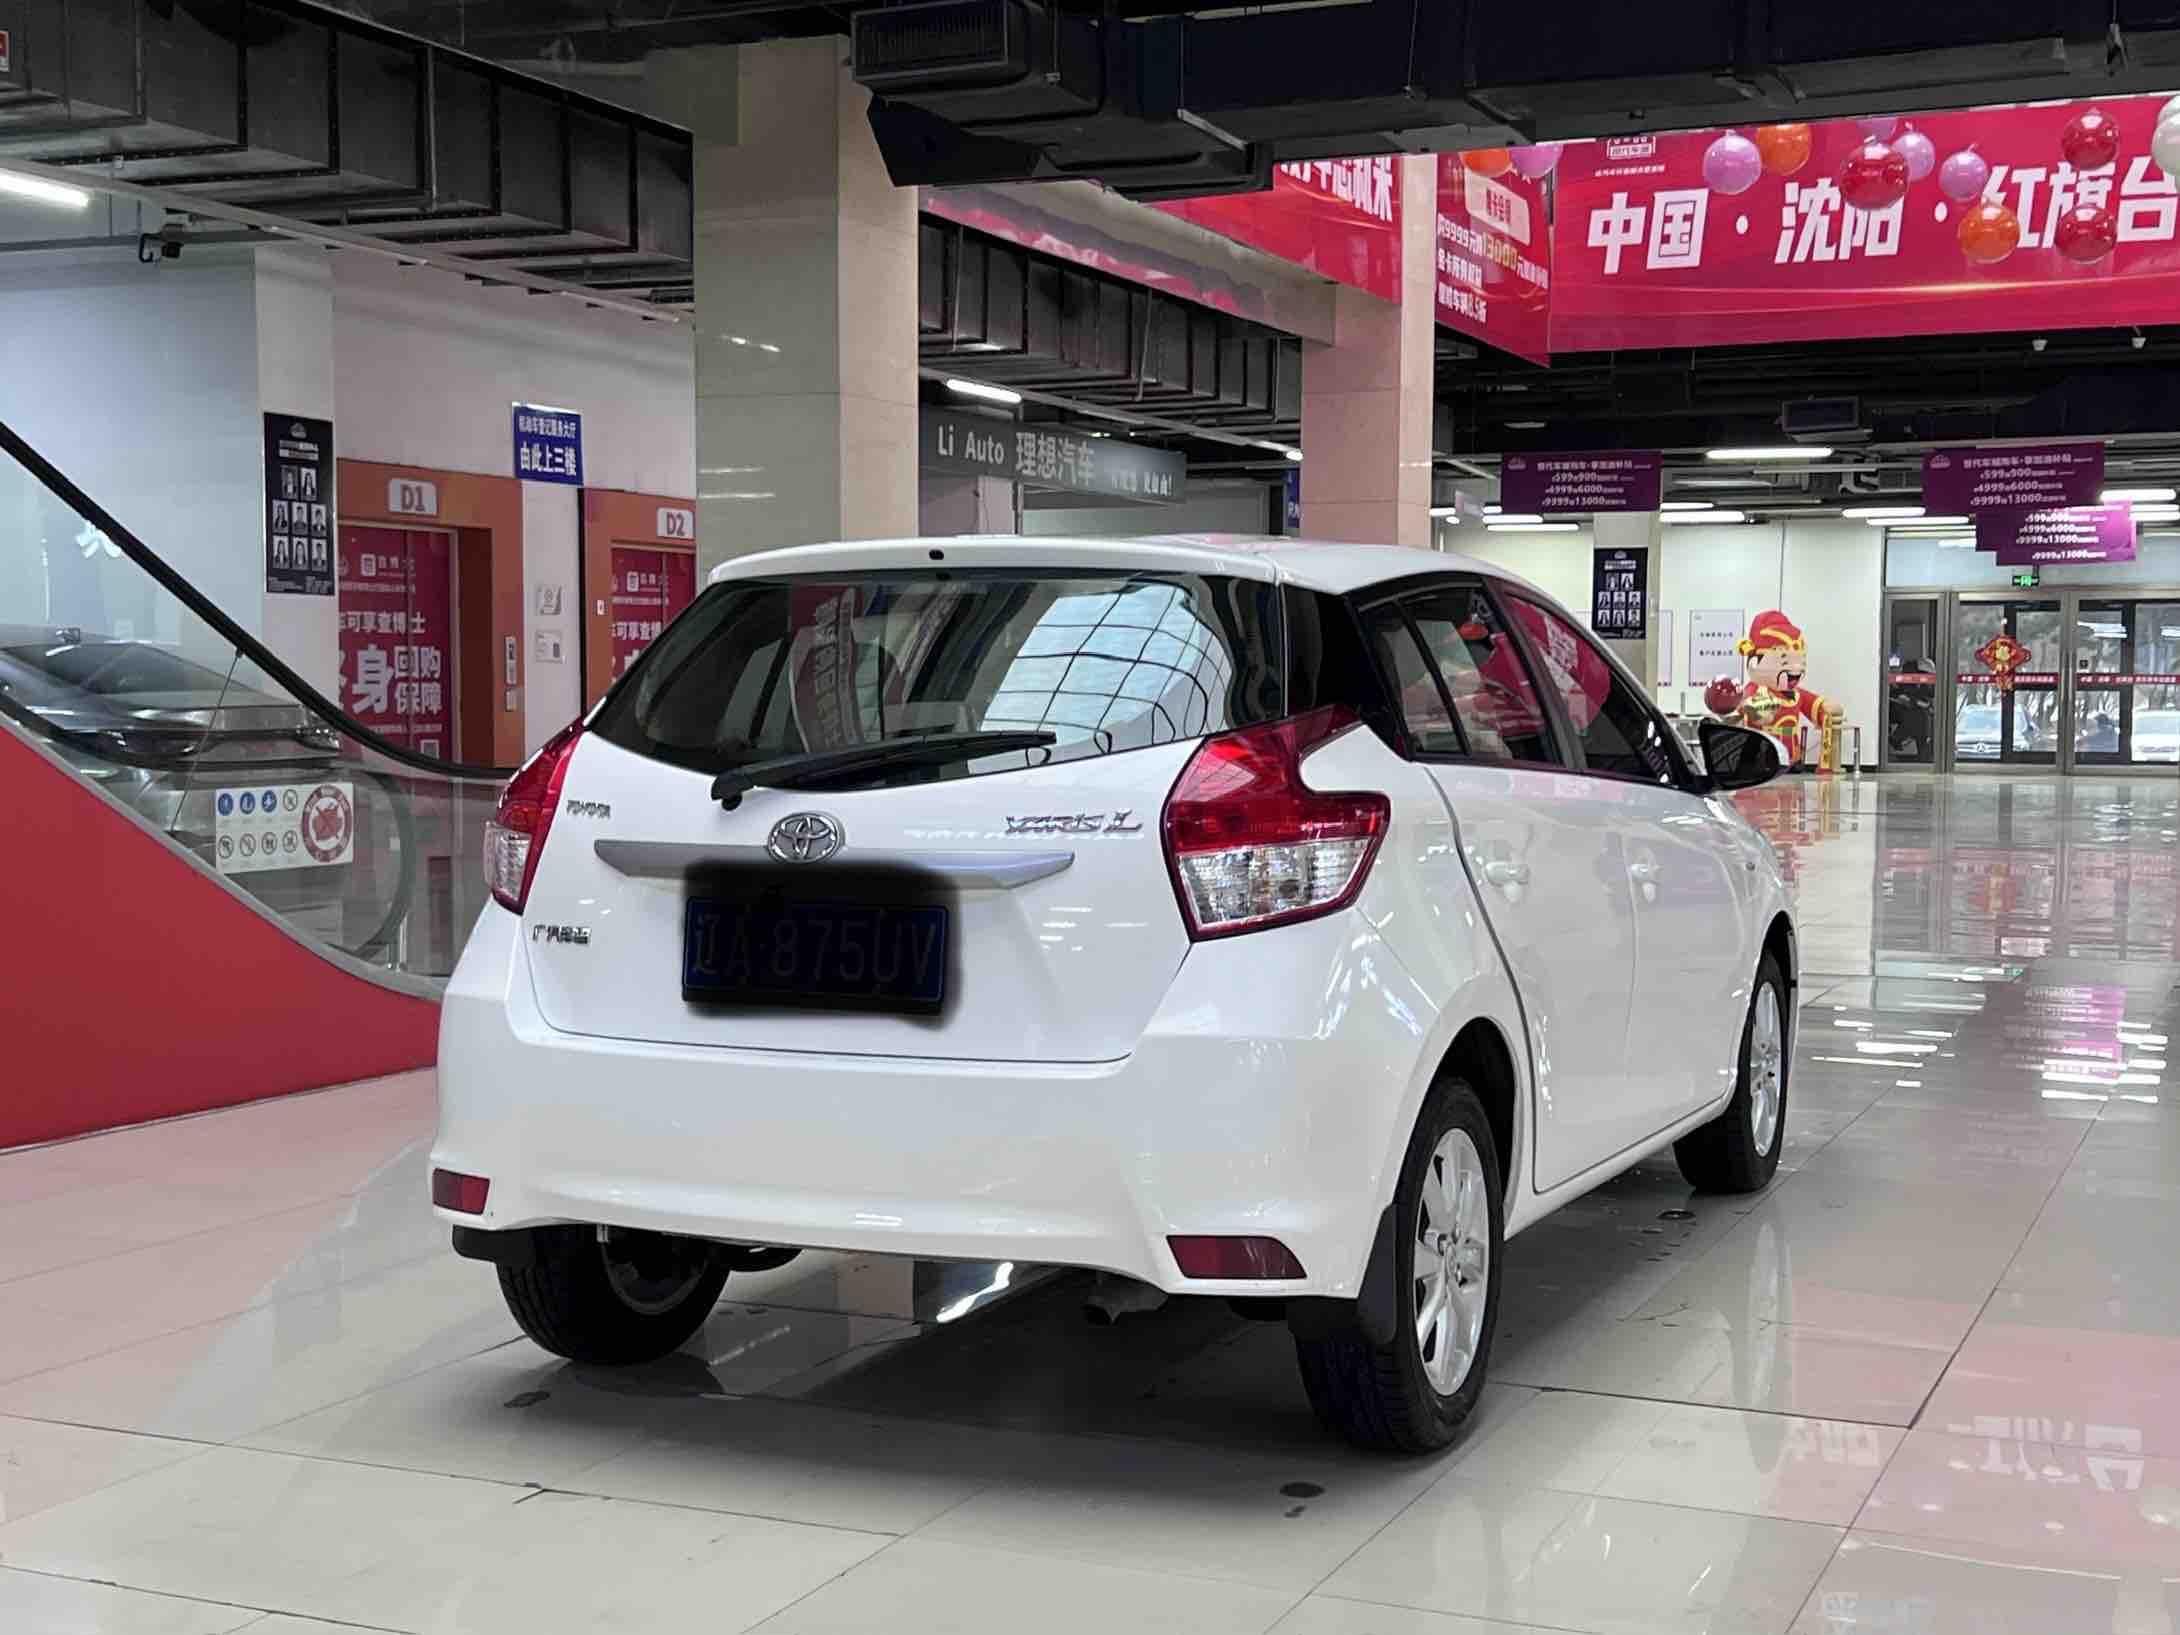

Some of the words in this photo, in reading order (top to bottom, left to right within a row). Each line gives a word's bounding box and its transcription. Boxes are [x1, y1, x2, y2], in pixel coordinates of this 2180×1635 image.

[520, 441, 577, 476] 由此上三楼
[938, 425, 954, 456] Li
[964, 431, 1005, 464] Auto
[1016, 432, 1097, 487] 理想汽车
[401, 484, 425, 512] D1
[666, 512, 685, 536] D2
[394, 645, 441, 679] 回购
[395, 681, 443, 715] 保障
